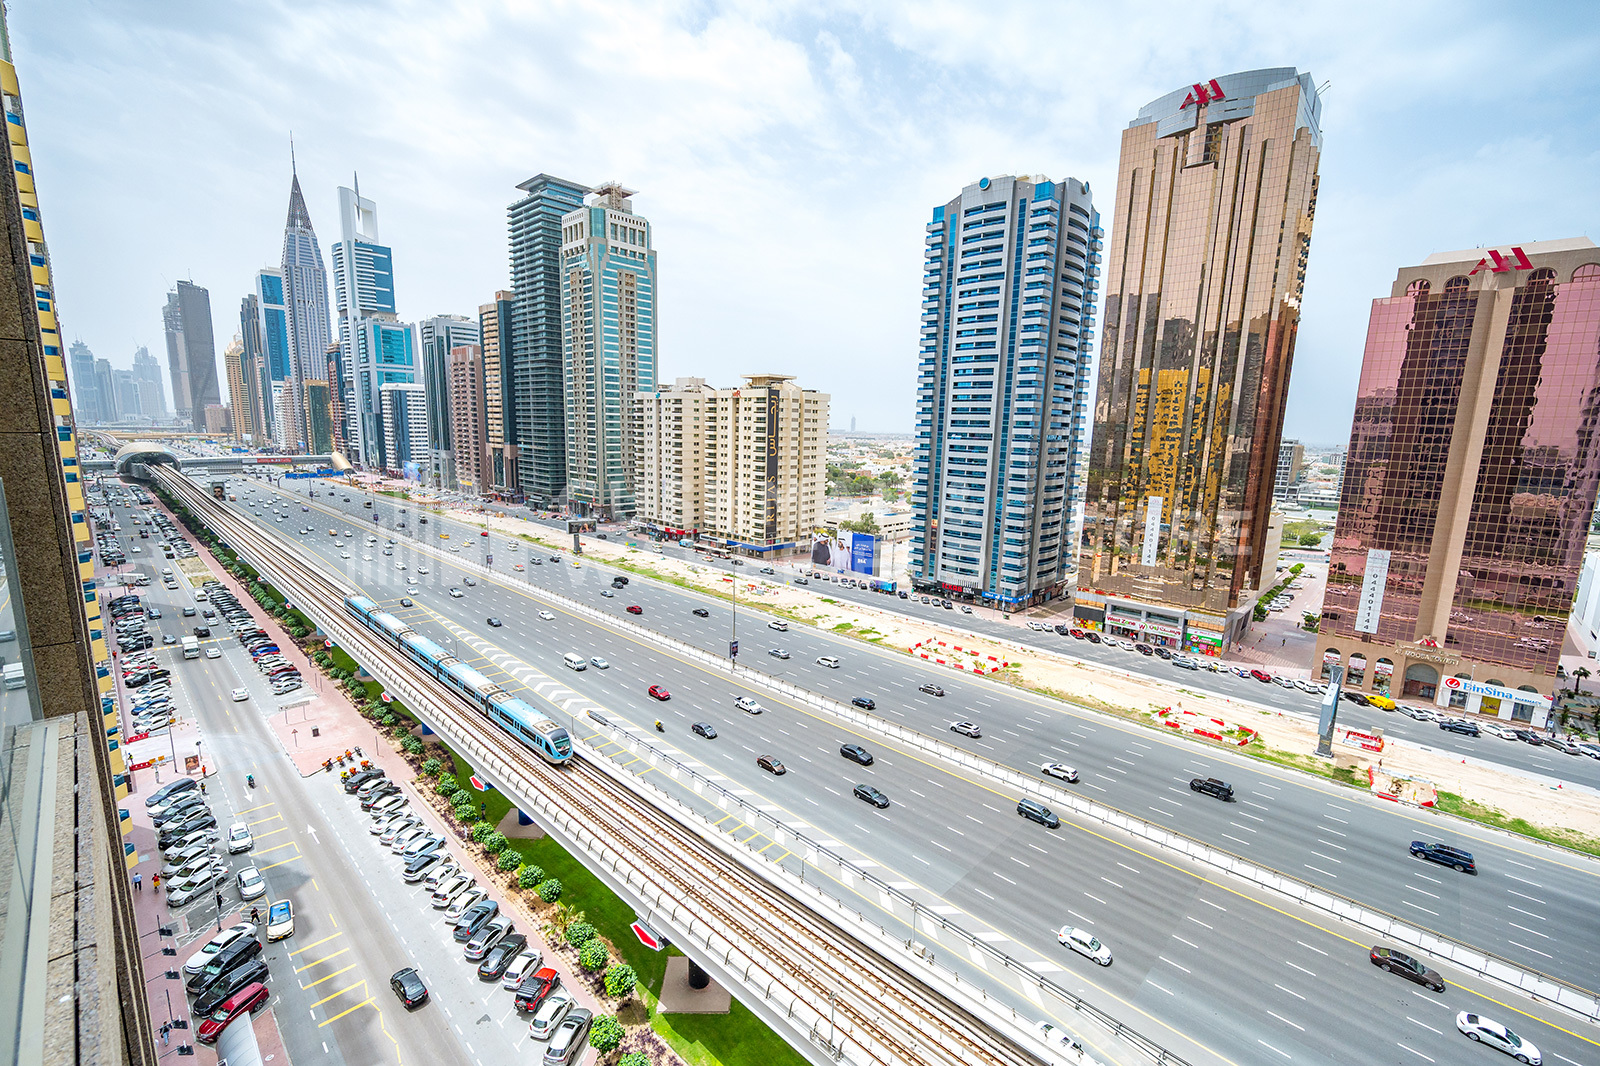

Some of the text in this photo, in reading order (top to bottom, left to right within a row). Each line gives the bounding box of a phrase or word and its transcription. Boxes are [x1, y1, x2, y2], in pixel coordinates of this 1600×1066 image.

[766, 475, 777, 522] RIJAS
[941, 582, 963, 593] TEXAS
[1363, 573, 1379, 630] 044401144
[1107, 616, 1121, 624] West
[1121, 618, 1136, 627] Zone
[1514, 696, 1542, 705] PHARMACY
